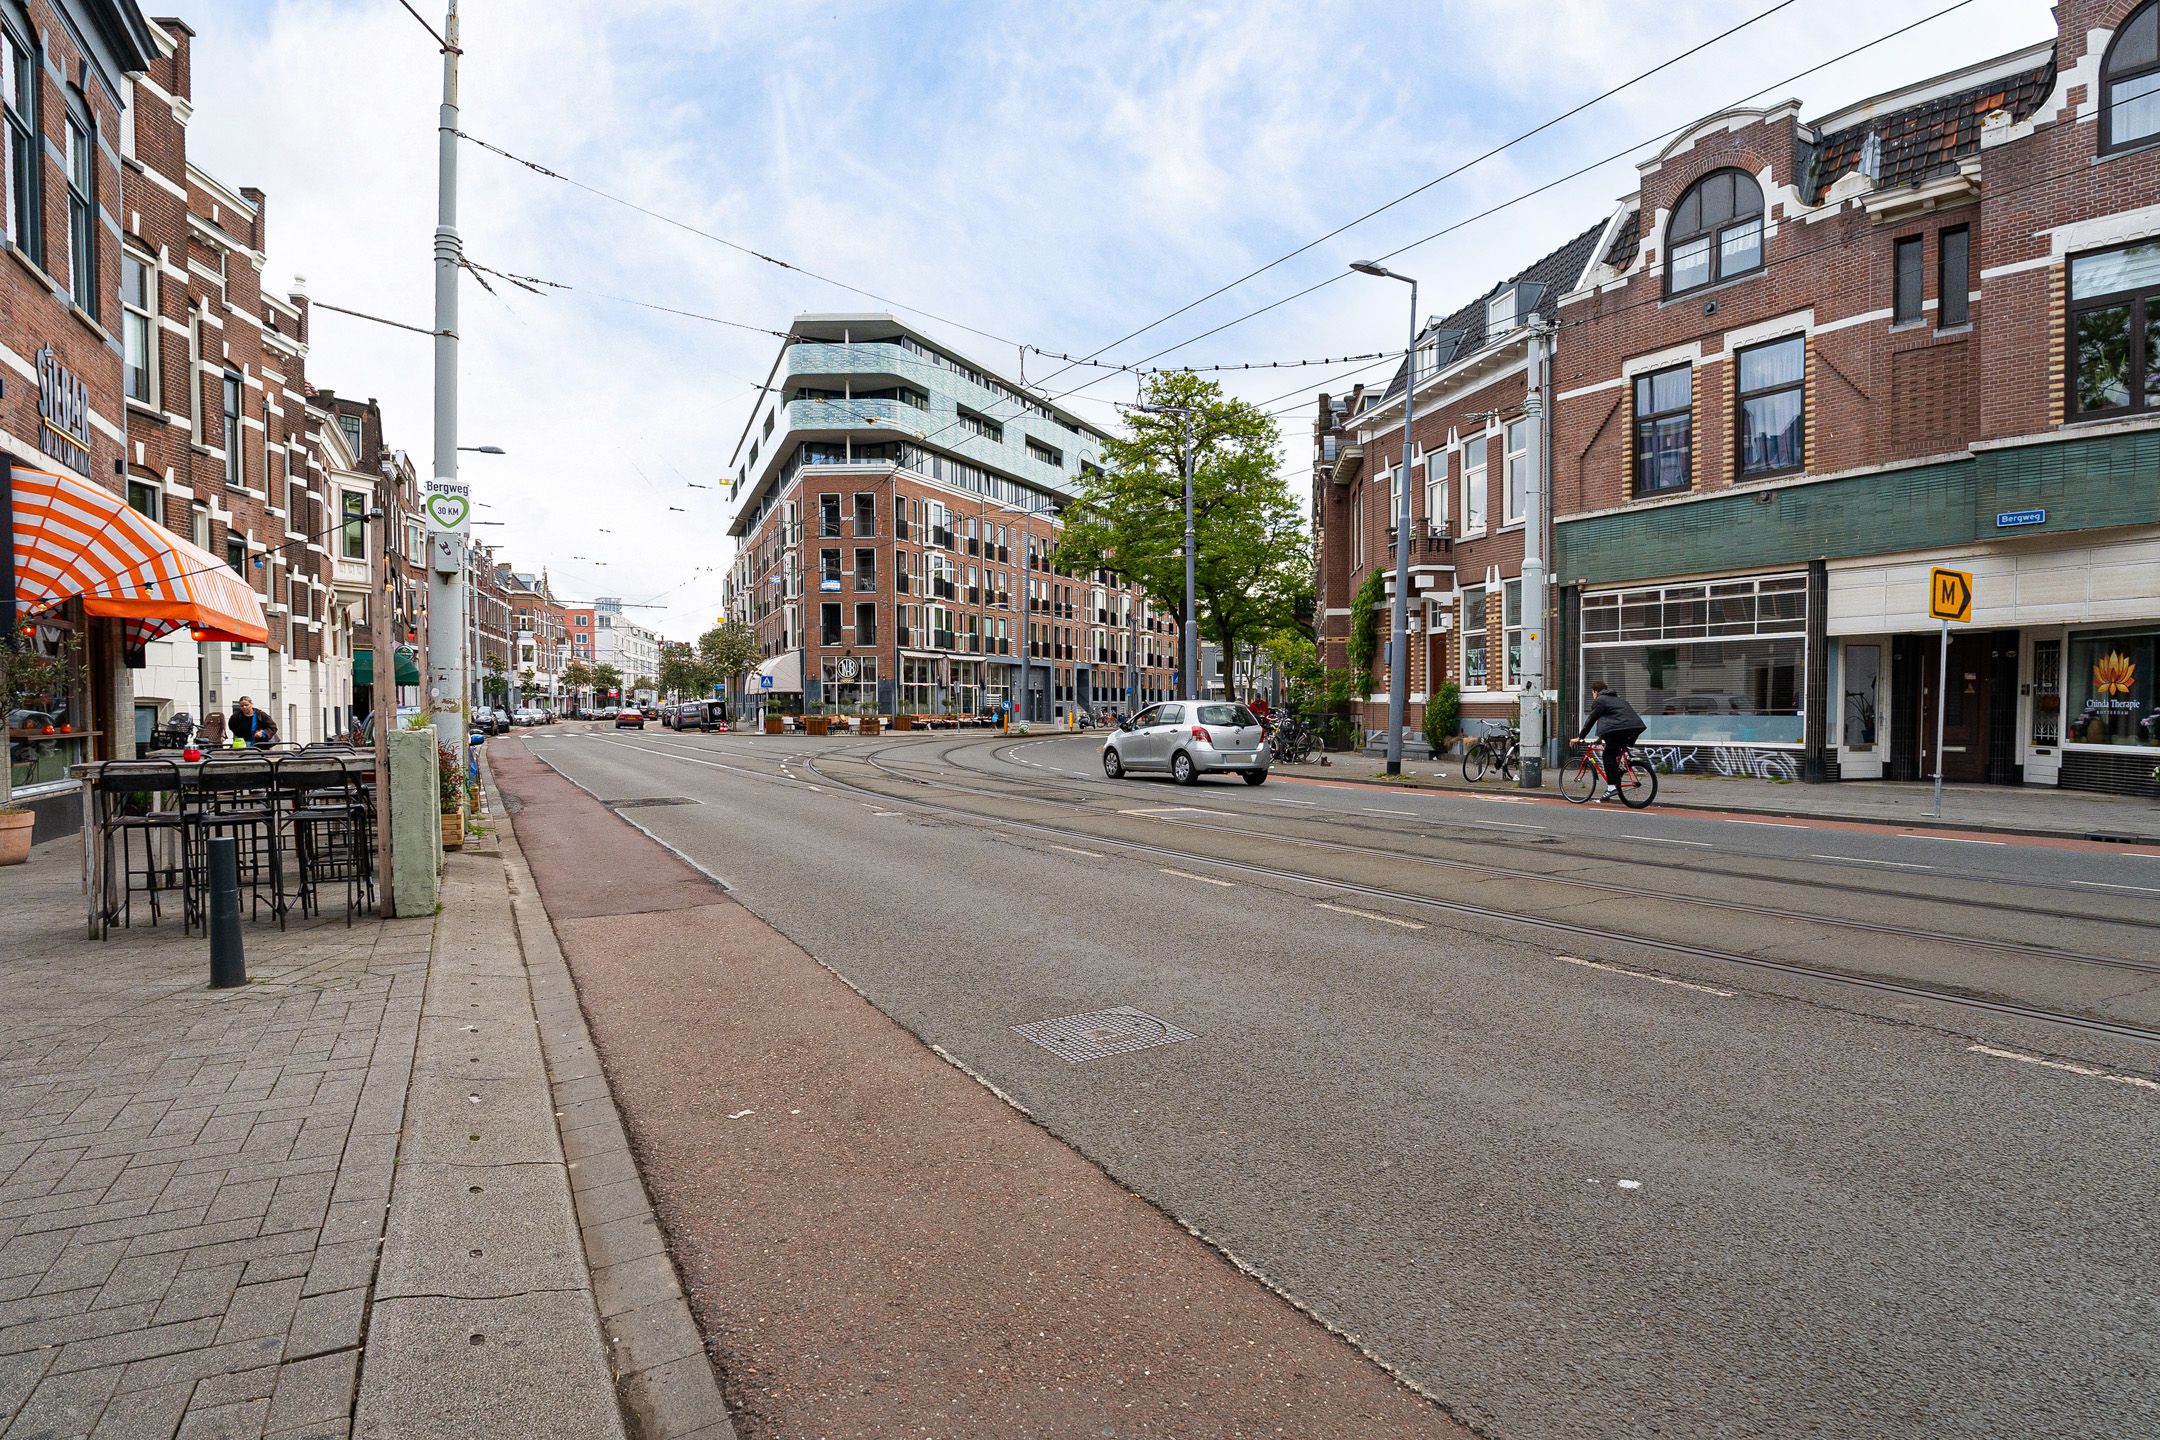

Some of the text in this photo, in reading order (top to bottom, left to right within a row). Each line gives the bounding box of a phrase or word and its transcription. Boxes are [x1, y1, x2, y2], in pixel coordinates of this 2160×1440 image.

[426, 481, 469, 496] Bergweg
[437, 506, 459, 516] 30 KM
[2001, 513, 2041, 523] Bergweg
[1942, 580, 1955, 605] M
[2086, 699, 2141, 711] Chinda Therapie
